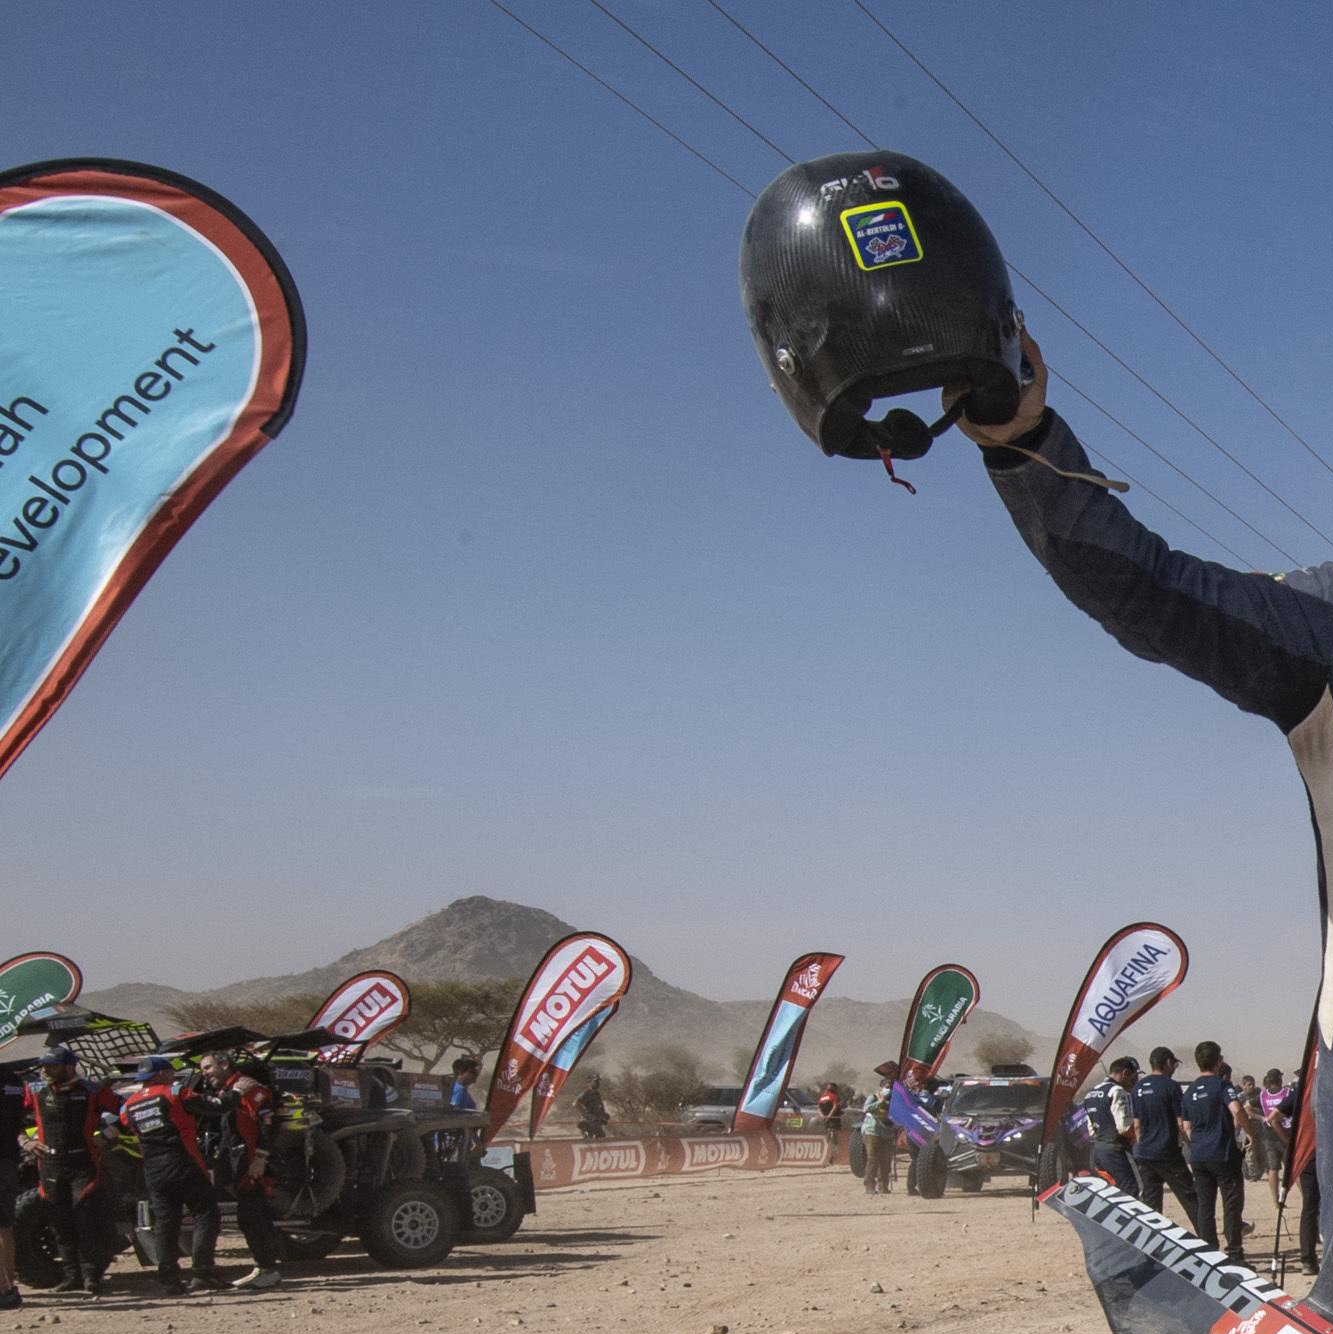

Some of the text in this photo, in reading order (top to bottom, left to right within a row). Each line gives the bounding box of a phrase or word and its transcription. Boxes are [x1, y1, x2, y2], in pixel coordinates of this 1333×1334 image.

[529, 954, 609, 1047] MOTUL
[1087, 943, 1169, 1038] AQUAFINA
[327, 989, 392, 1049] OTUL
[582, 1147, 638, 1171] MOTUL
[692, 1141, 742, 1163] MOTUL
[784, 1141, 823, 1160] MOTUL
